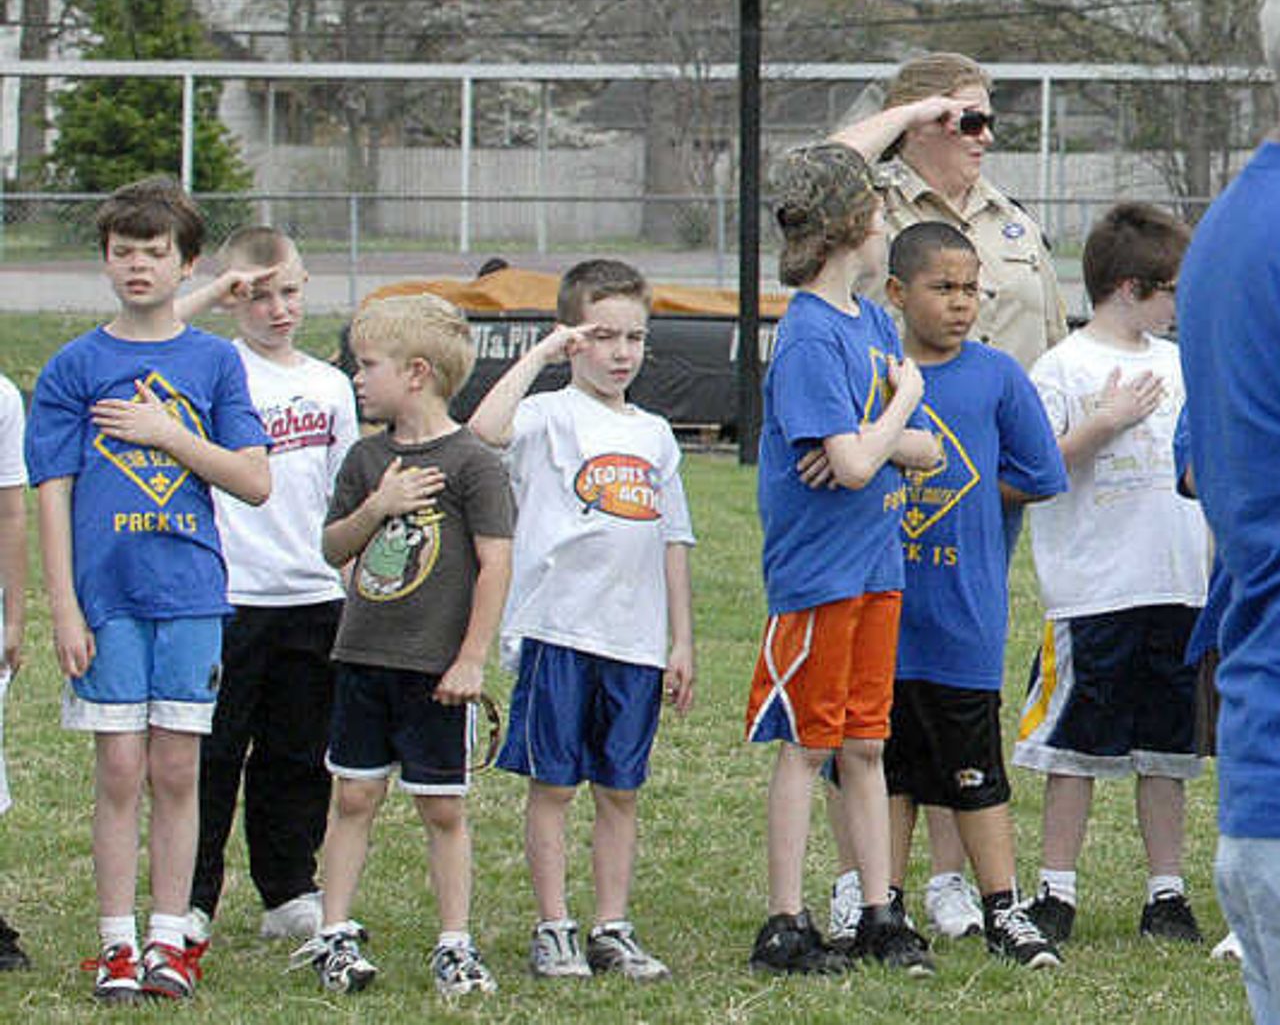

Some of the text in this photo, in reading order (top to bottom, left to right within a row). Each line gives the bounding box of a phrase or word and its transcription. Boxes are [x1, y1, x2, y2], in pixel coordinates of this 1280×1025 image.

[263, 406, 328, 438] ahas
[114, 513, 197, 532] PACK 15
[933, 547, 958, 565] 15
